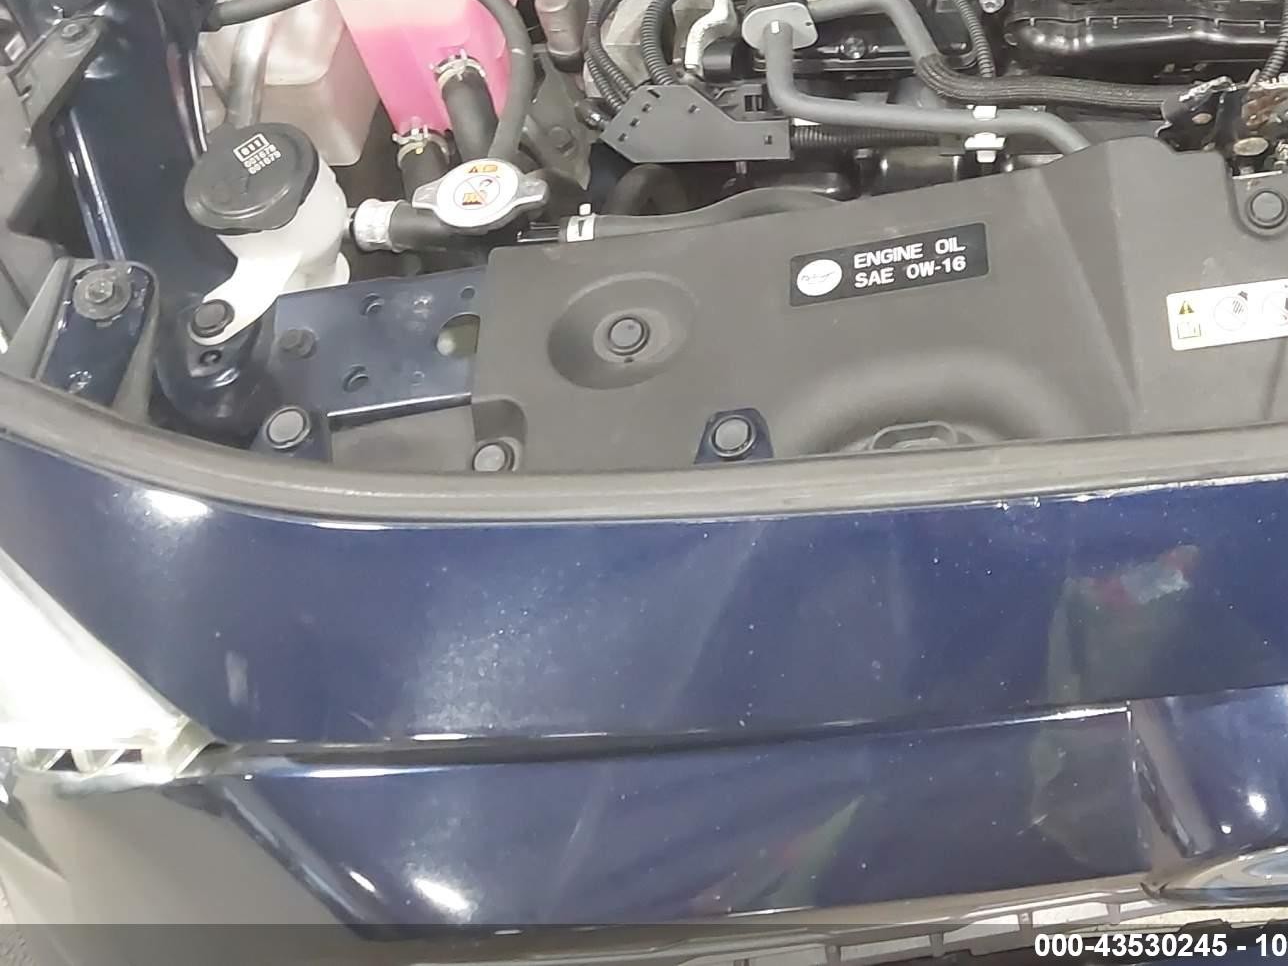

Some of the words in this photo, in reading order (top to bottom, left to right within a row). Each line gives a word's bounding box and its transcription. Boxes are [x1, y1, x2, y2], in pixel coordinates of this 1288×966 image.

[853, 242, 924, 270] ENGINE
[934, 236, 967, 255] OIL
[854, 266, 895, 289] SAE
[906, 255, 967, 281] 0W-16
